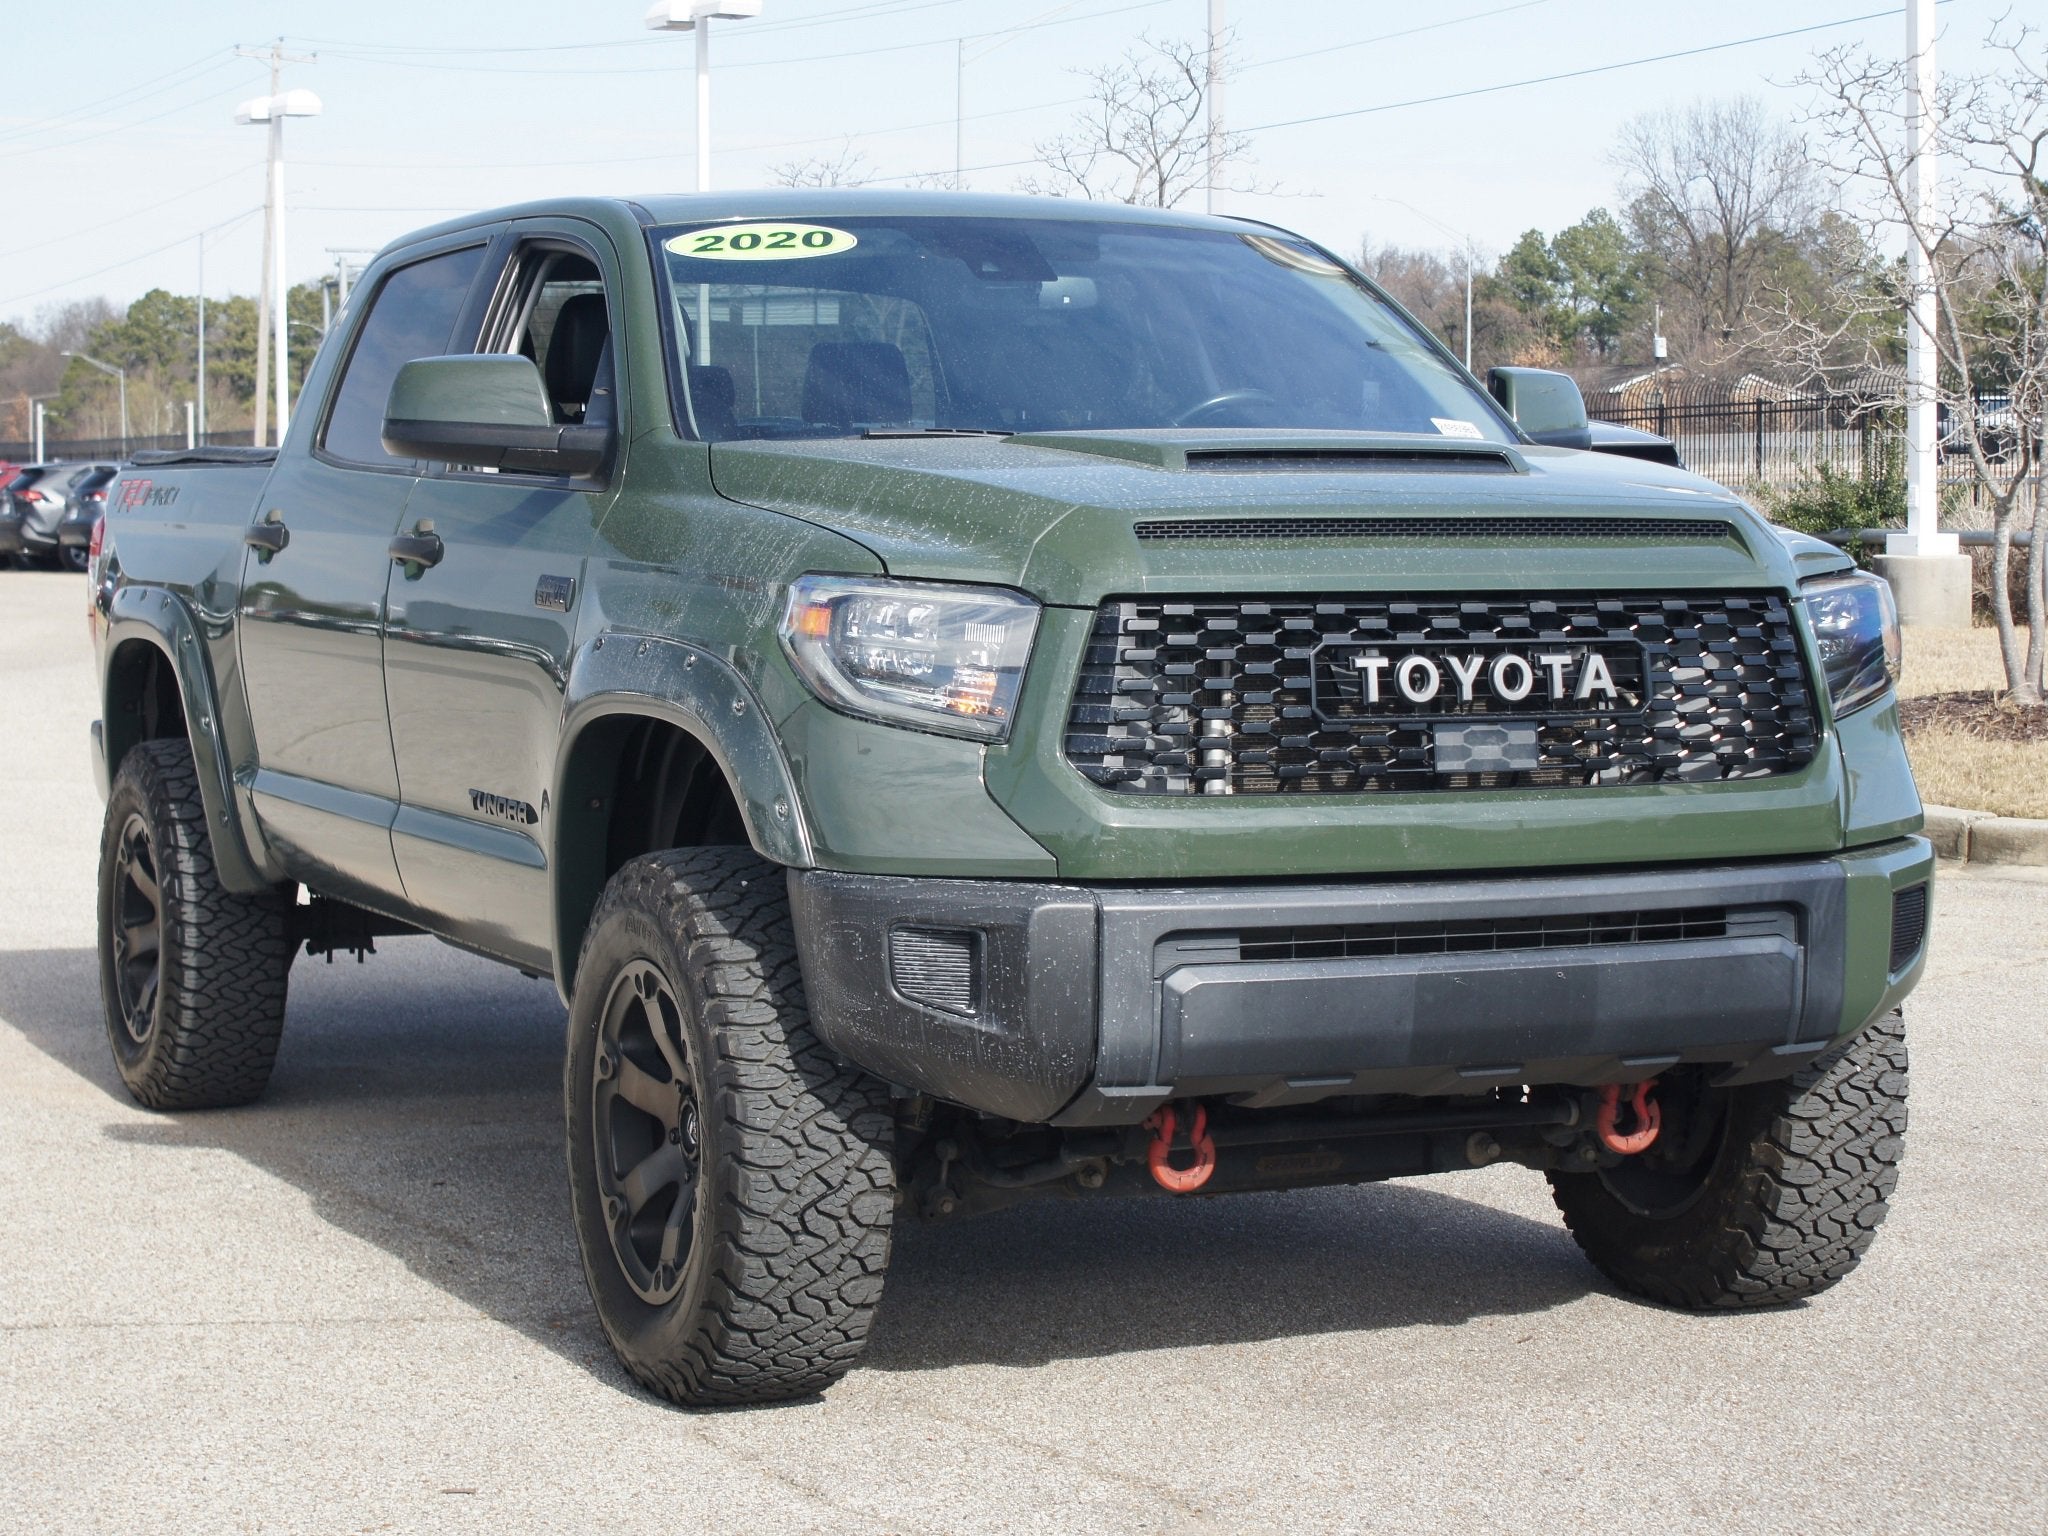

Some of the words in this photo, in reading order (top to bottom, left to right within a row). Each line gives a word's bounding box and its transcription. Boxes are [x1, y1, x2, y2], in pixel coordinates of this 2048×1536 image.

[692, 230, 834, 253] 2020
[1349, 653, 1618, 703] TOYOTA
[469, 788, 528, 824] TUNDRA
